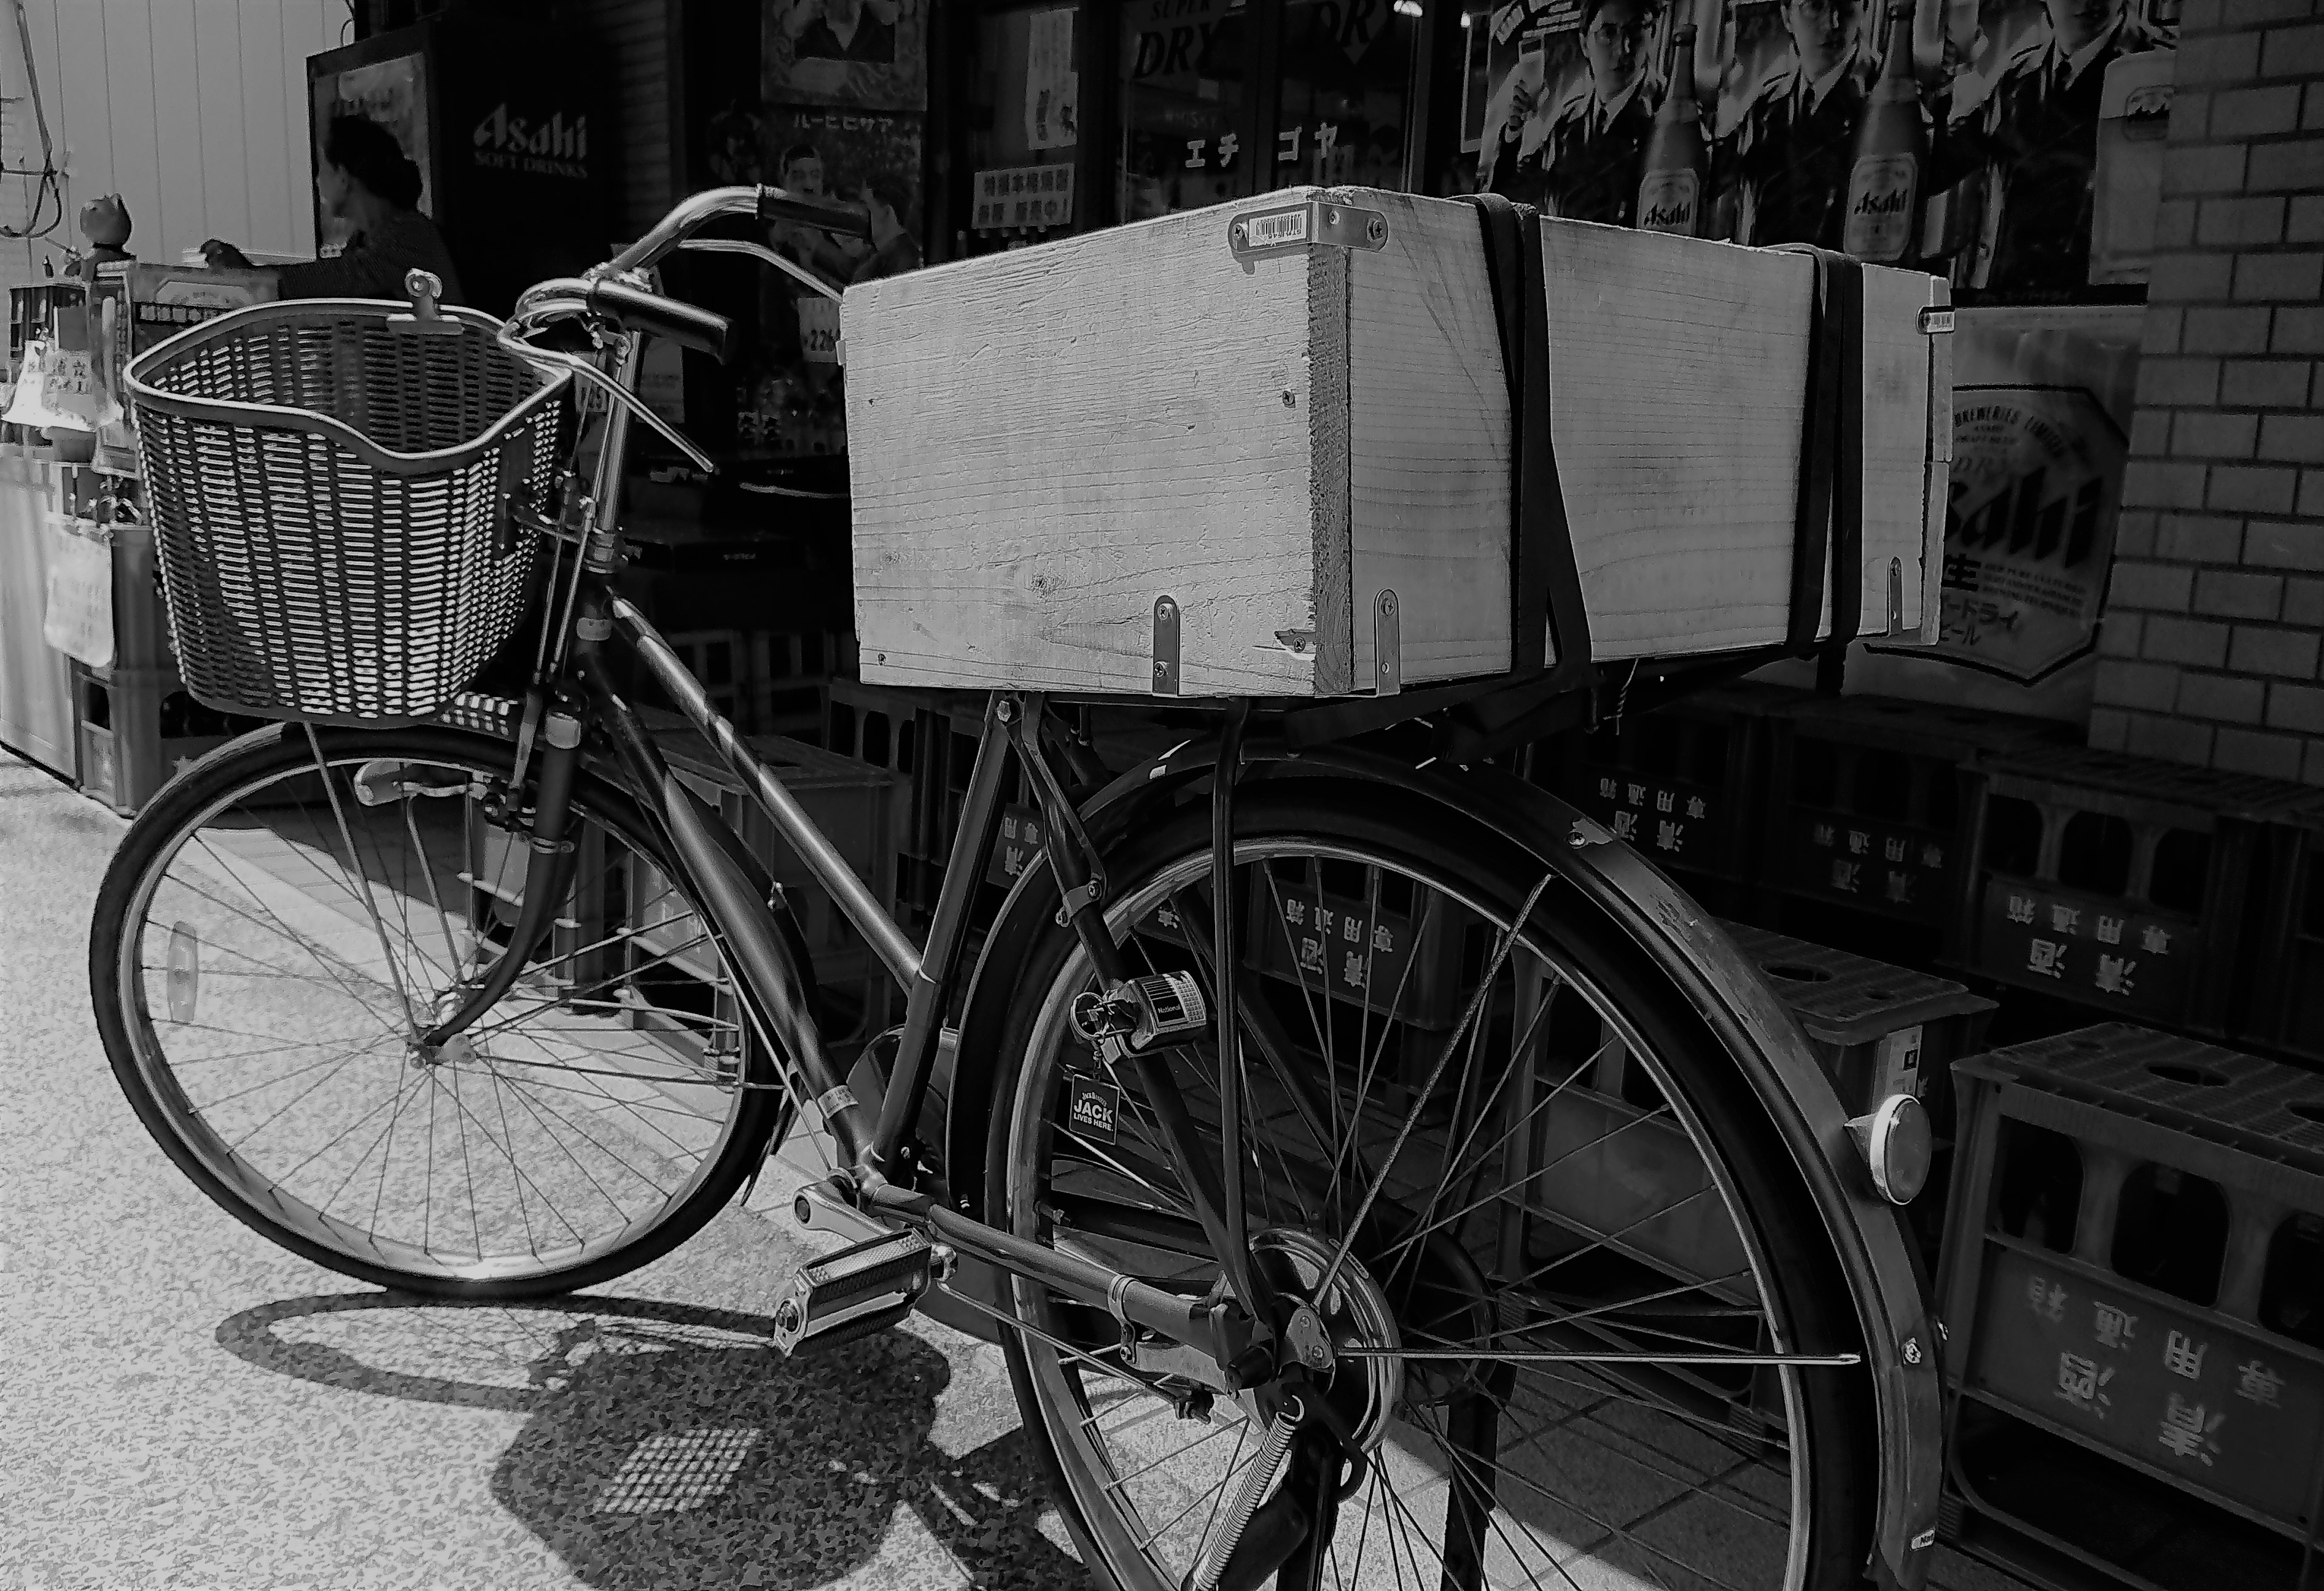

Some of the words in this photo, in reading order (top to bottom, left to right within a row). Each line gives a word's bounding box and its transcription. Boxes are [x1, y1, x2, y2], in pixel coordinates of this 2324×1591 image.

[473, 101, 588, 161] Asahi
[473, 151, 517, 169] SOFT
[523, 157, 588, 179] DRINKS
[1644, 201, 1691, 227] Asahi
[1854, 189, 1908, 214] Asahi
[1944, 467, 2103, 569] sahi
[1158, 1003, 1181, 1014] National
[1073, 1112, 1092, 1124] LIVES
[1094, 1119, 1114, 1132] HERE.
[1074, 1099, 1113, 1124] JACK
